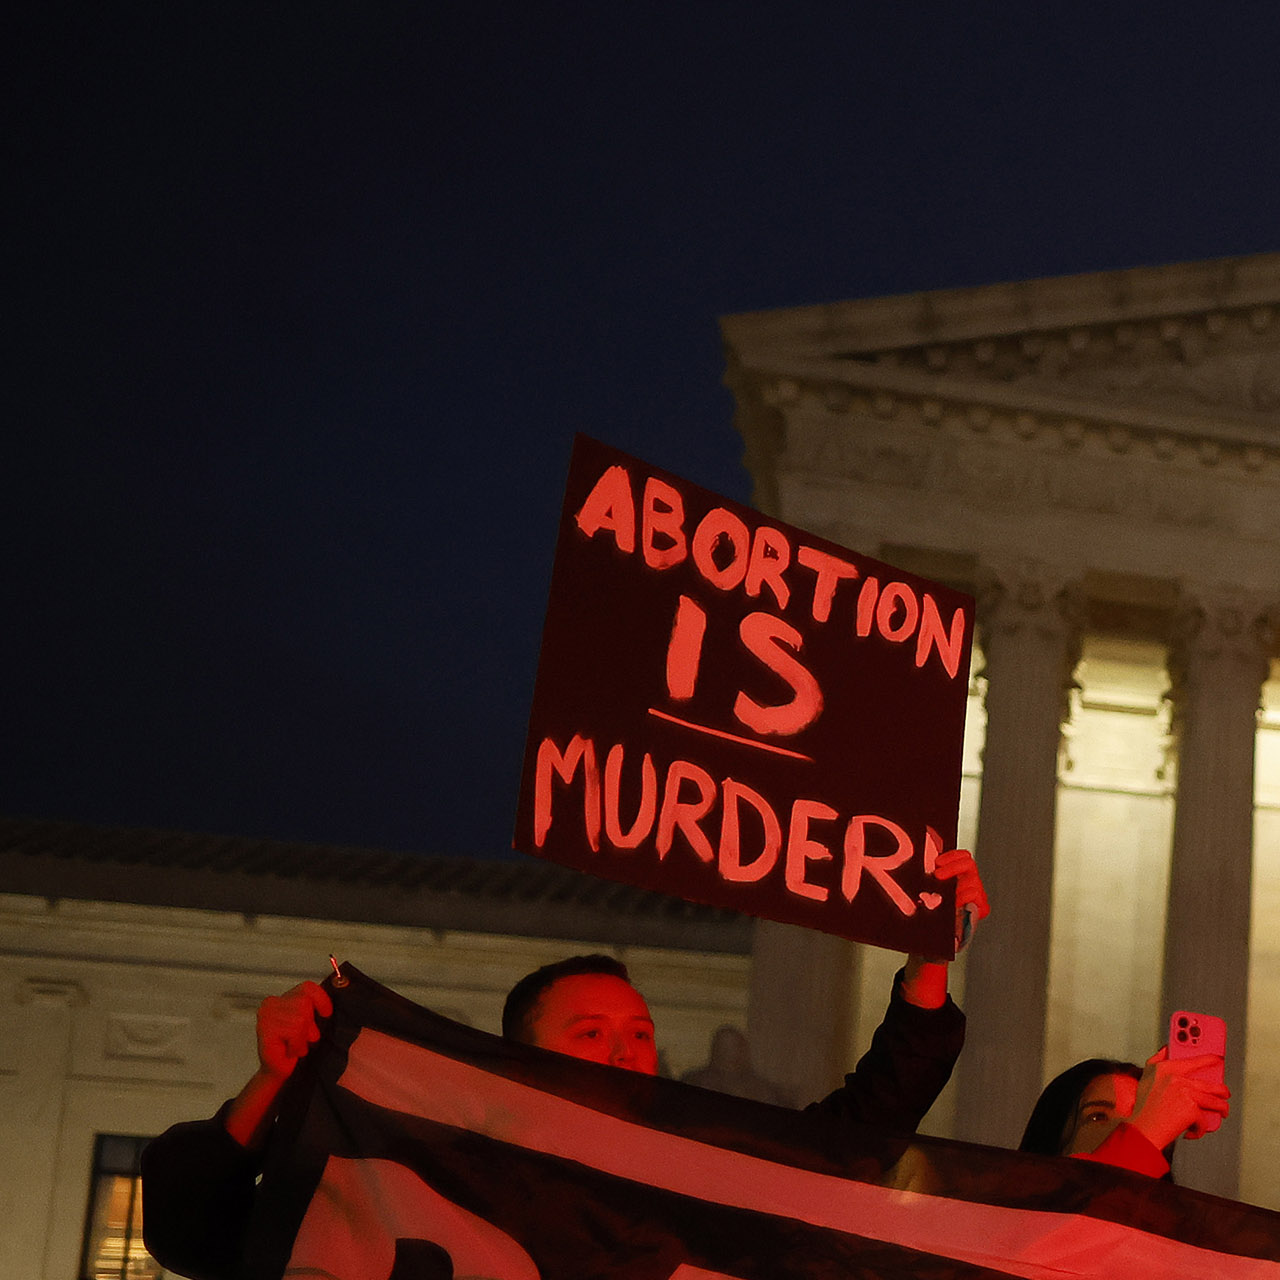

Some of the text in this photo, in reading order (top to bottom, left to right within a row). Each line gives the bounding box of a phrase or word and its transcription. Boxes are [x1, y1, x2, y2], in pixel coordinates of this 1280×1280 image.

[575, 465, 965, 679] ABORTION
[666, 594, 824, 735] IS
[532, 733, 943, 917] MURDER!
